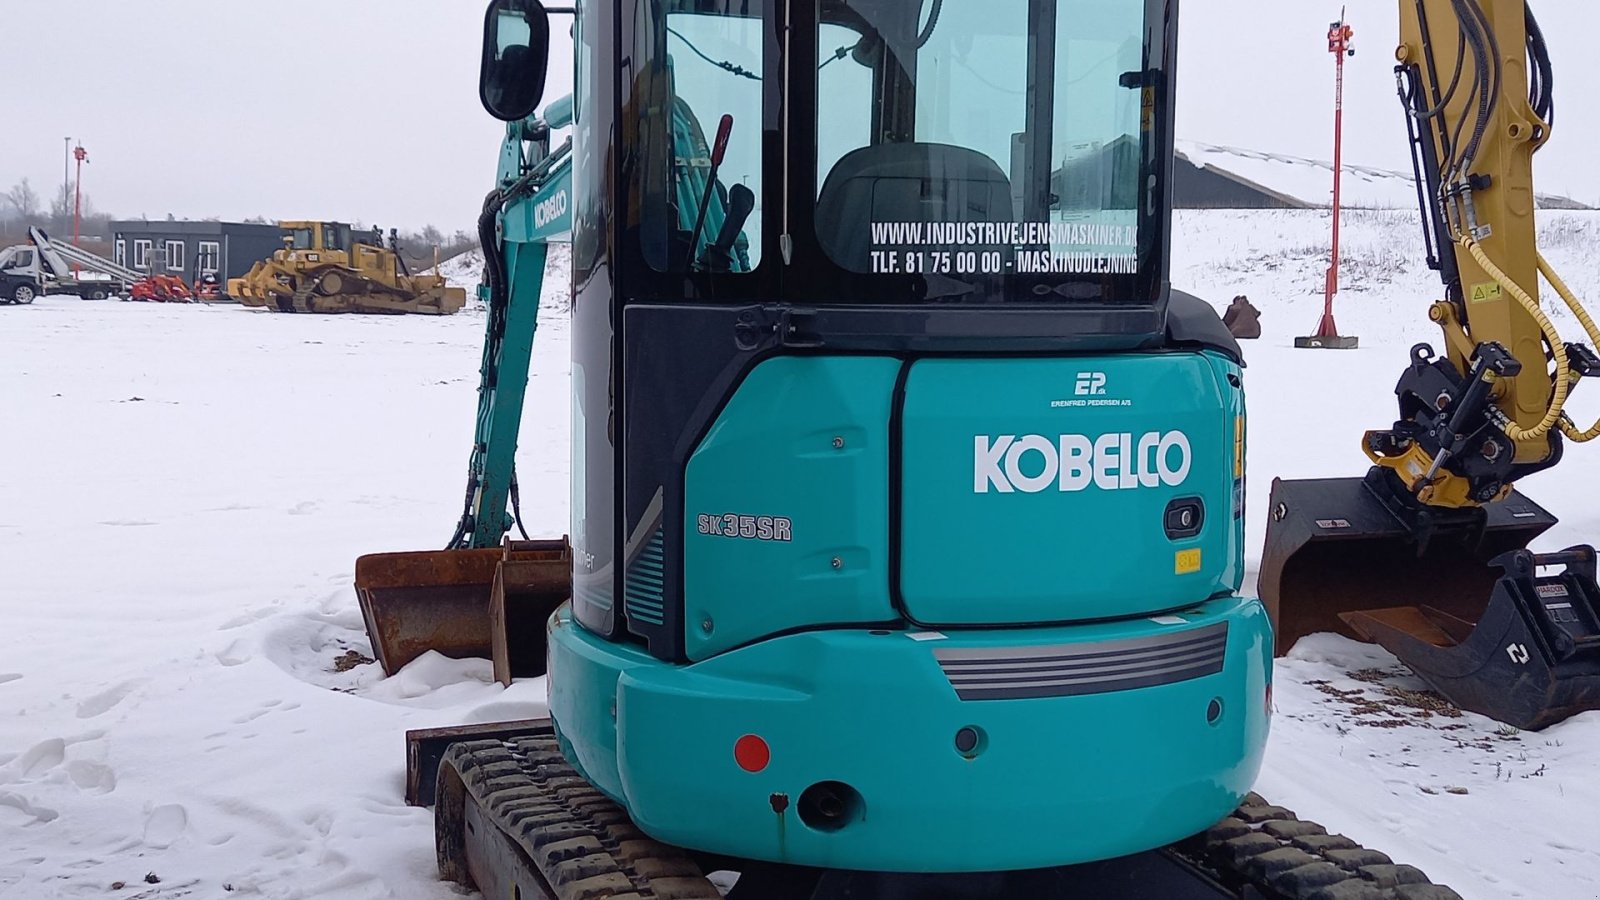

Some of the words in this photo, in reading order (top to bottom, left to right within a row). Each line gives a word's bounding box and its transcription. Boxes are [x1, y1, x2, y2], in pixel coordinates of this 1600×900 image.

[534, 190, 567, 229] KOBELCO
[871, 222, 1138, 246] WWW.INDUSTRIVEJENSMASKINER.DK
[871, 251, 899, 274] TLF.
[905, 251, 924, 274] 81
[931, 251, 951, 274] 75
[956, 251, 975, 274] 00
[981, 251, 1001, 274] 00
[1017, 251, 1137, 274] MASKINUDLEJNING
[974, 429, 1192, 494] KOBELCO
[698, 514, 792, 541] SK35SR
